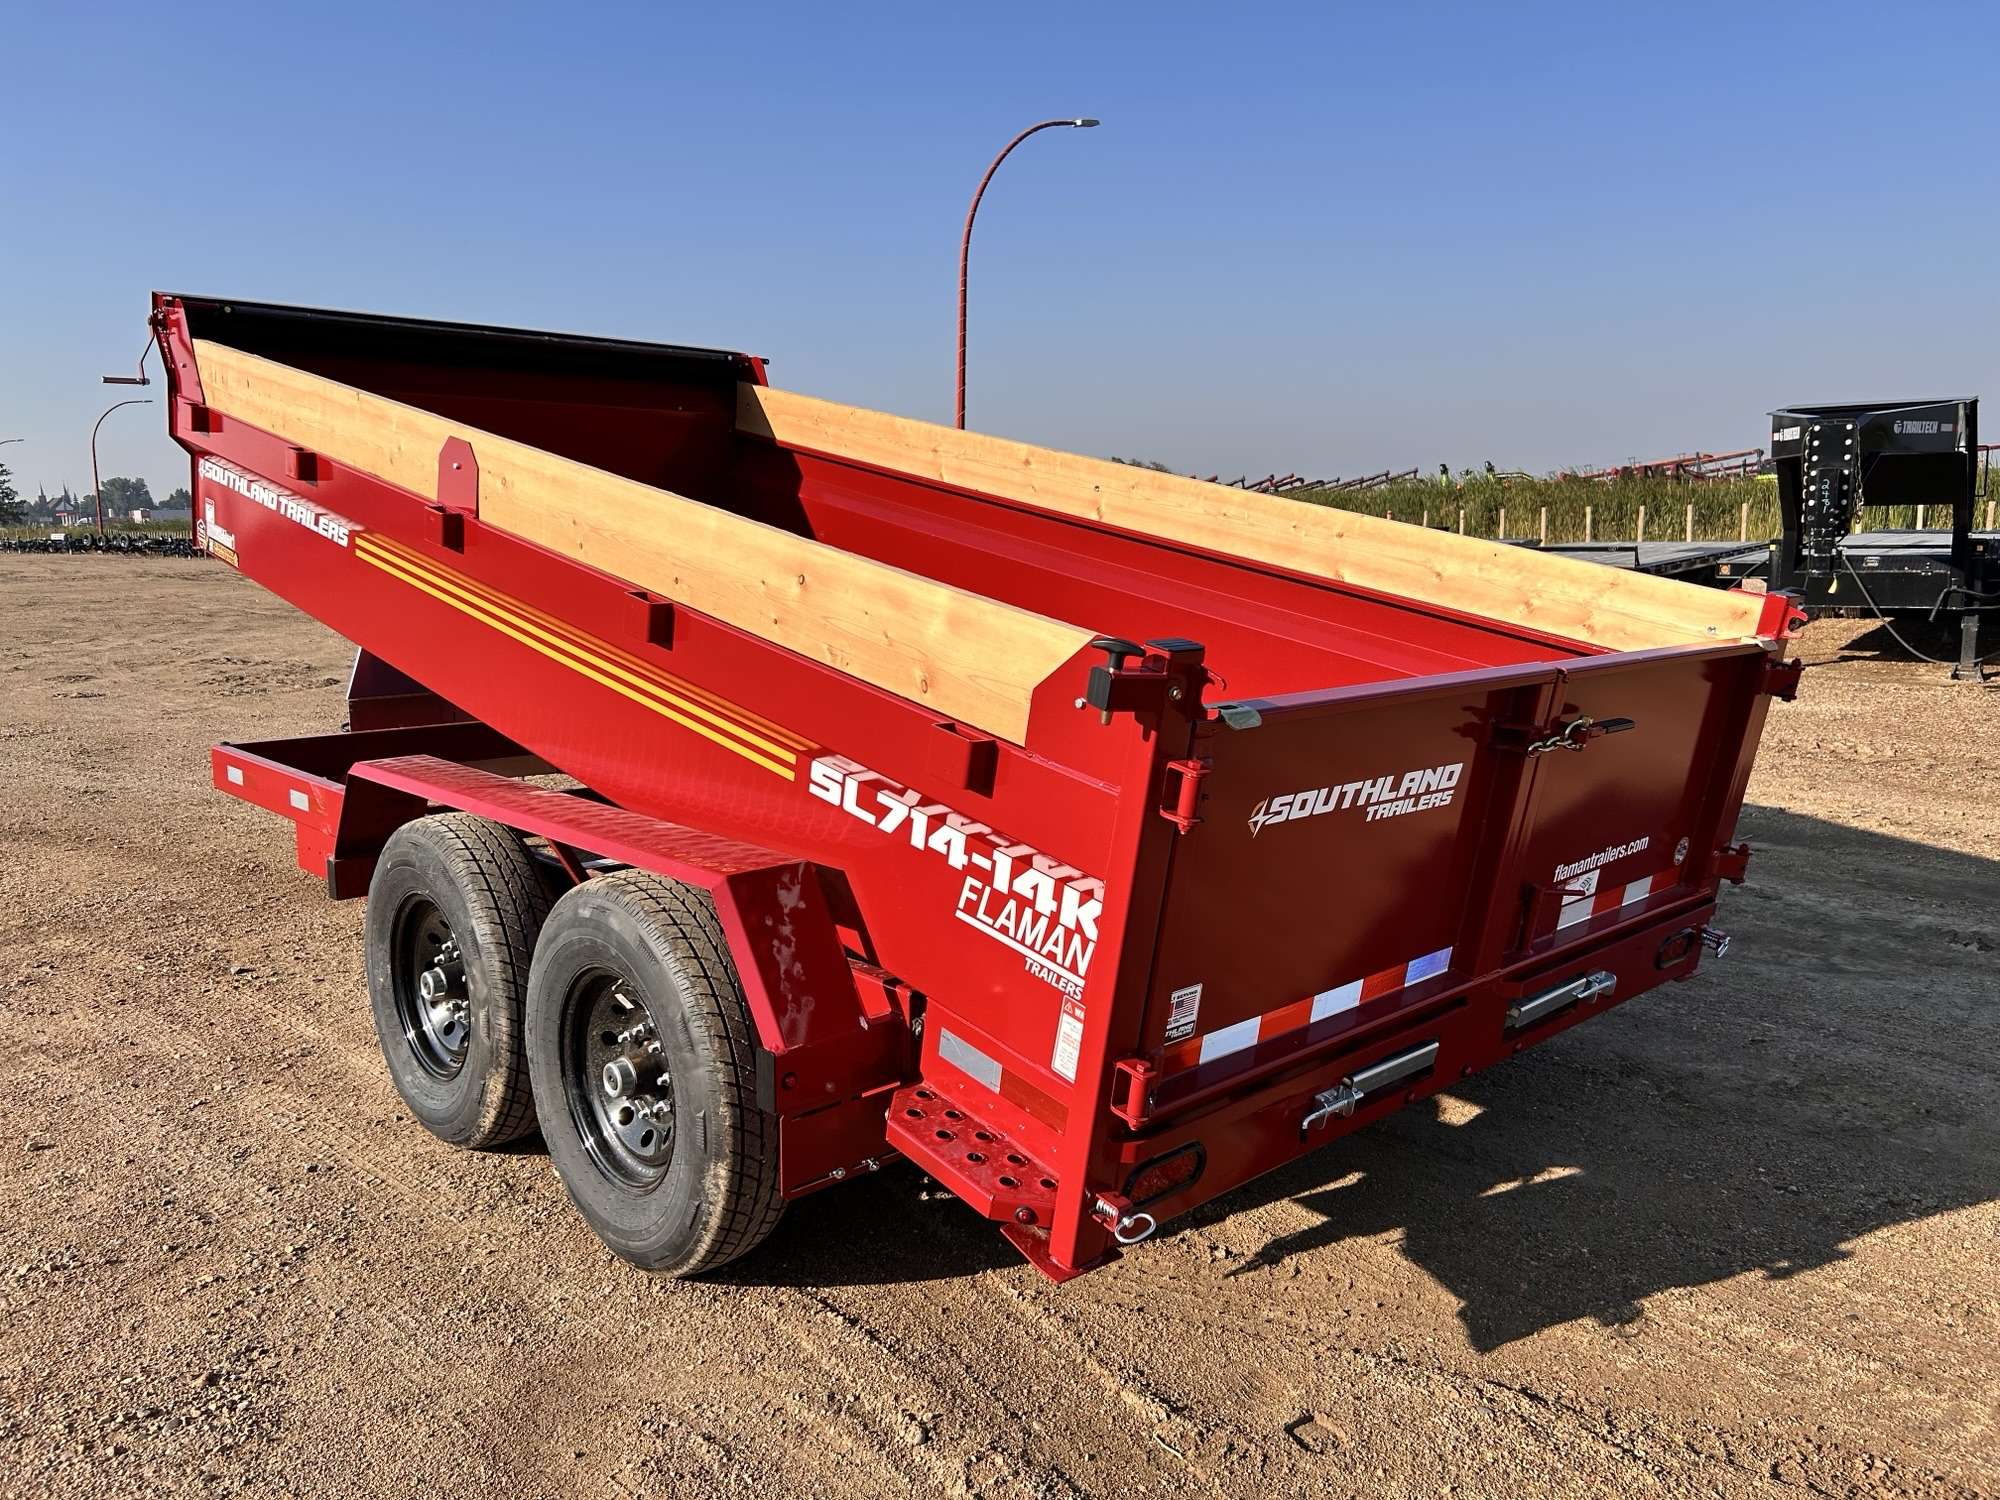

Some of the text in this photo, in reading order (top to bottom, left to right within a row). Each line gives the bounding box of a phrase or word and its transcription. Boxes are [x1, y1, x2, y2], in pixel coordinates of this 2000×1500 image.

[206, 461, 278, 511] SOUTHLAND
[279, 495, 350, 548] TRAILERS
[1264, 763, 1464, 825] SOUTHLAND
[1366, 789, 1455, 822] TRAILERS
[808, 758, 1103, 943] SL714-14K
[1553, 836, 1650, 883] flamantrailers.com
[958, 875, 1096, 977] FLAMAN
[1024, 957, 1084, 1001] TRAILERS
